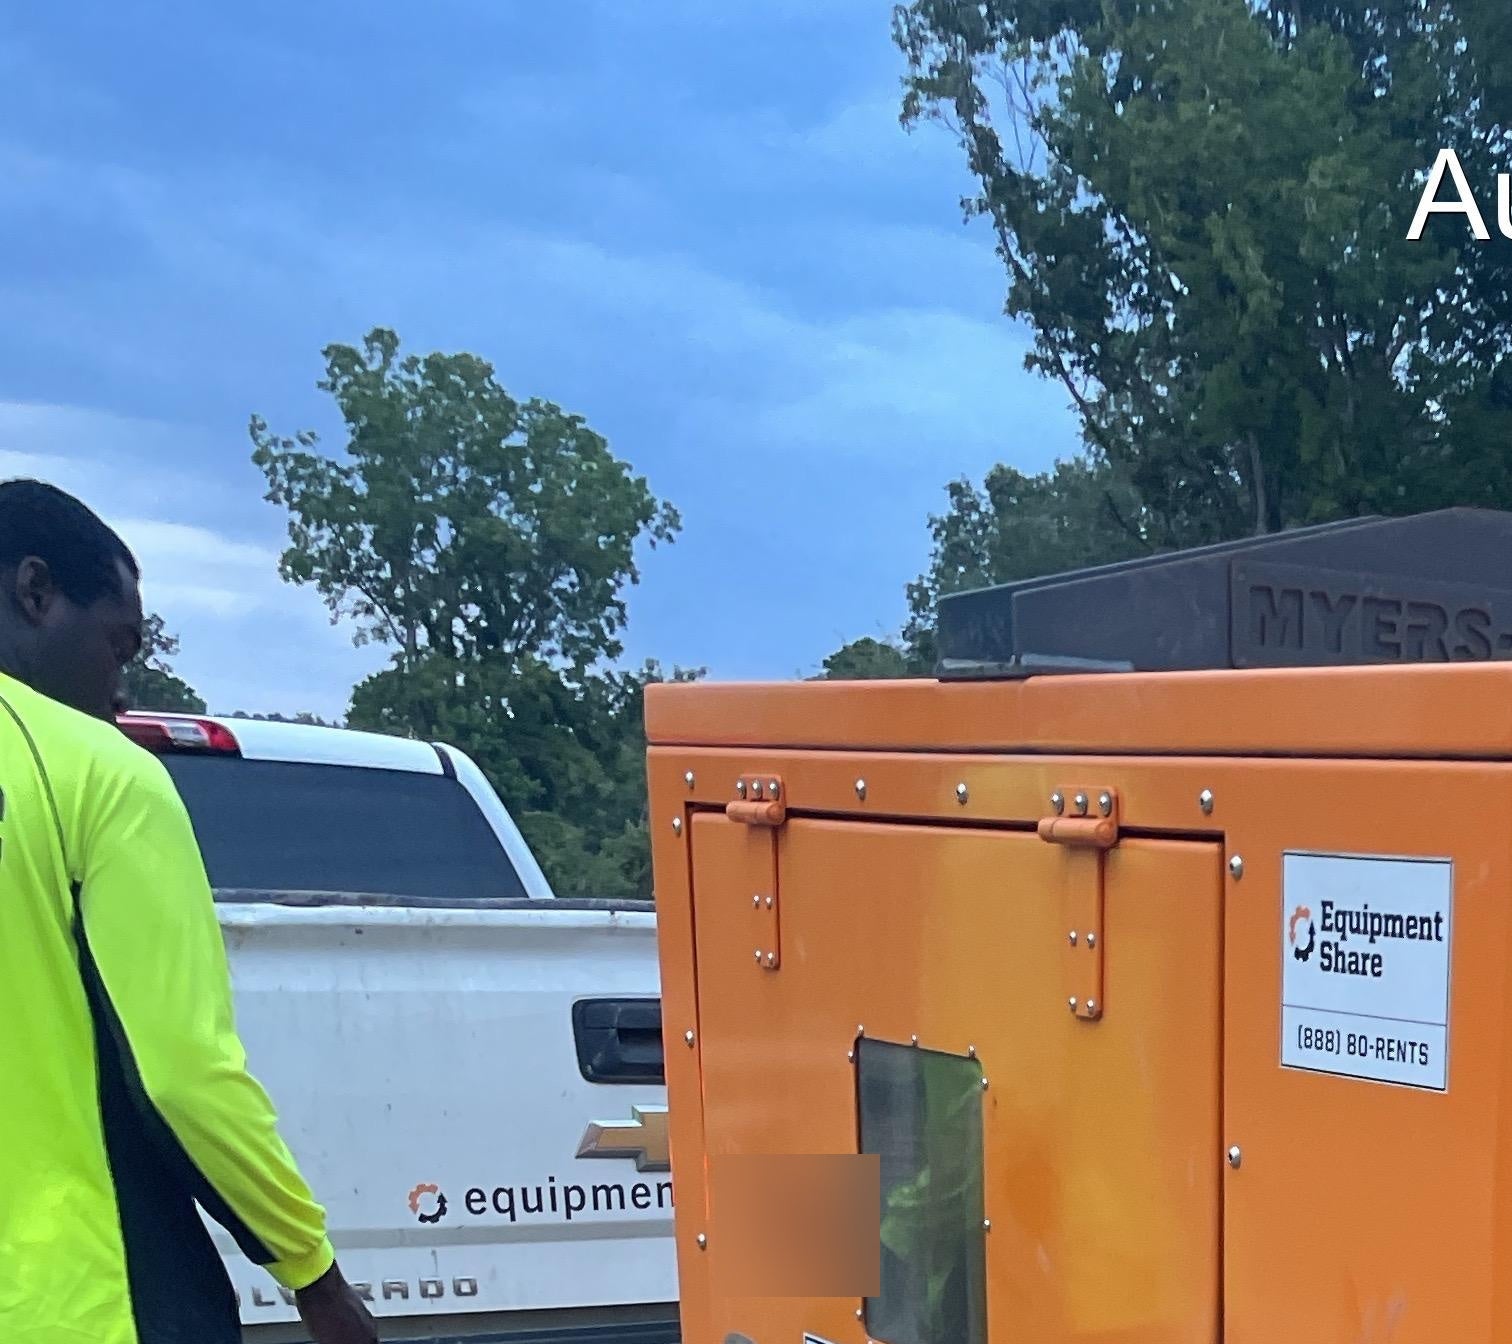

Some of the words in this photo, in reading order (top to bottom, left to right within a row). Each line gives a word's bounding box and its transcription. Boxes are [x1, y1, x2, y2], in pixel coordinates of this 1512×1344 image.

[1319, 900, 1443, 944] Equipment
[1319, 940, 1383, 978] Share
[1297, 1024, 1342, 1055] (888)
[1347, 1033, 1430, 1067] 80-RENTS
